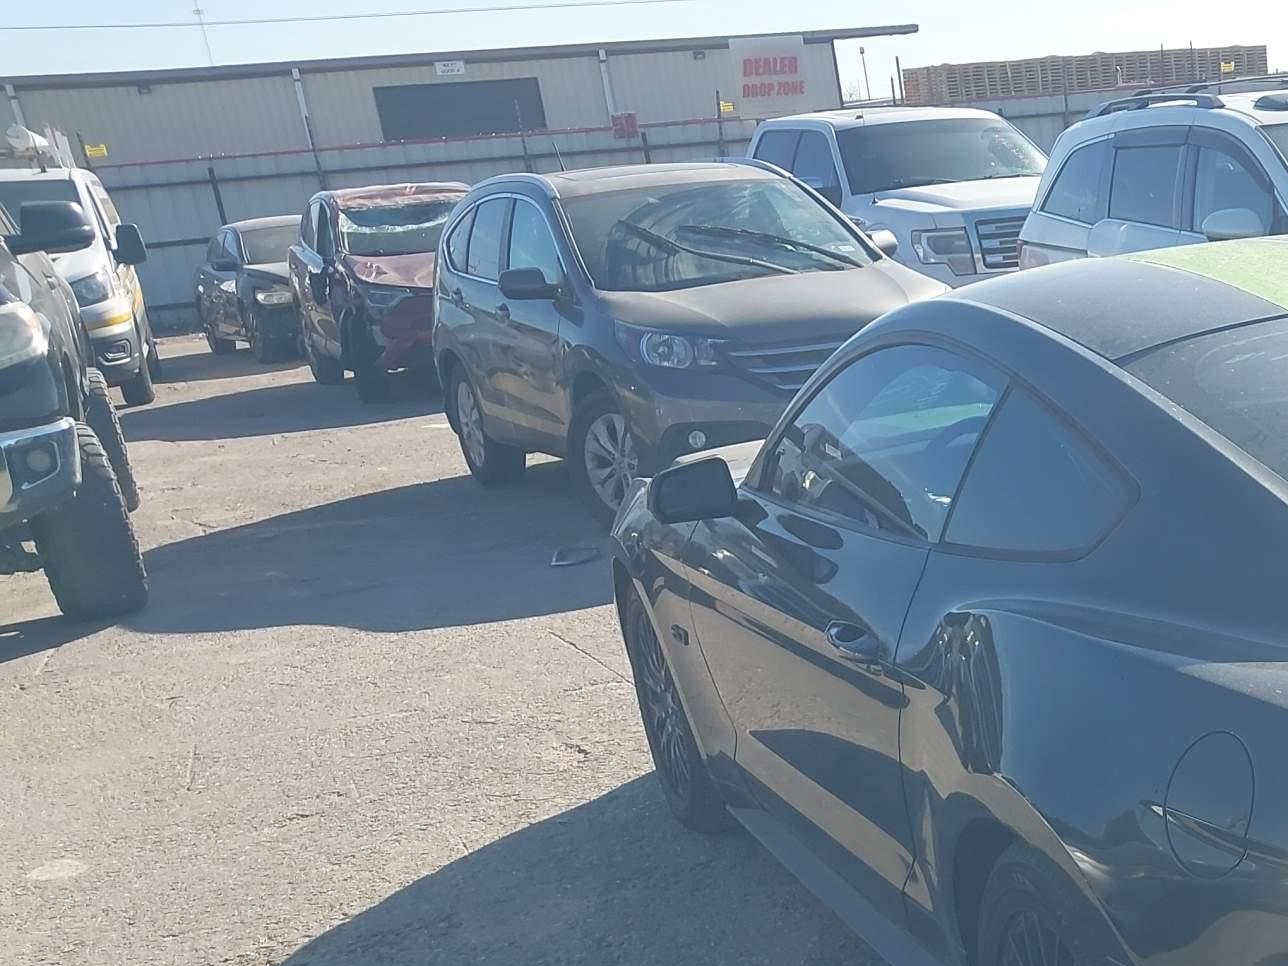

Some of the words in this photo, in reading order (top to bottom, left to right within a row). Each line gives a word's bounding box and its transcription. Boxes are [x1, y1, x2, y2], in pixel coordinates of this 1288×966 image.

[743, 55, 798, 77] DEALER
[742, 83, 775, 98] DROP
[776, 80, 805, 96] ZONE
